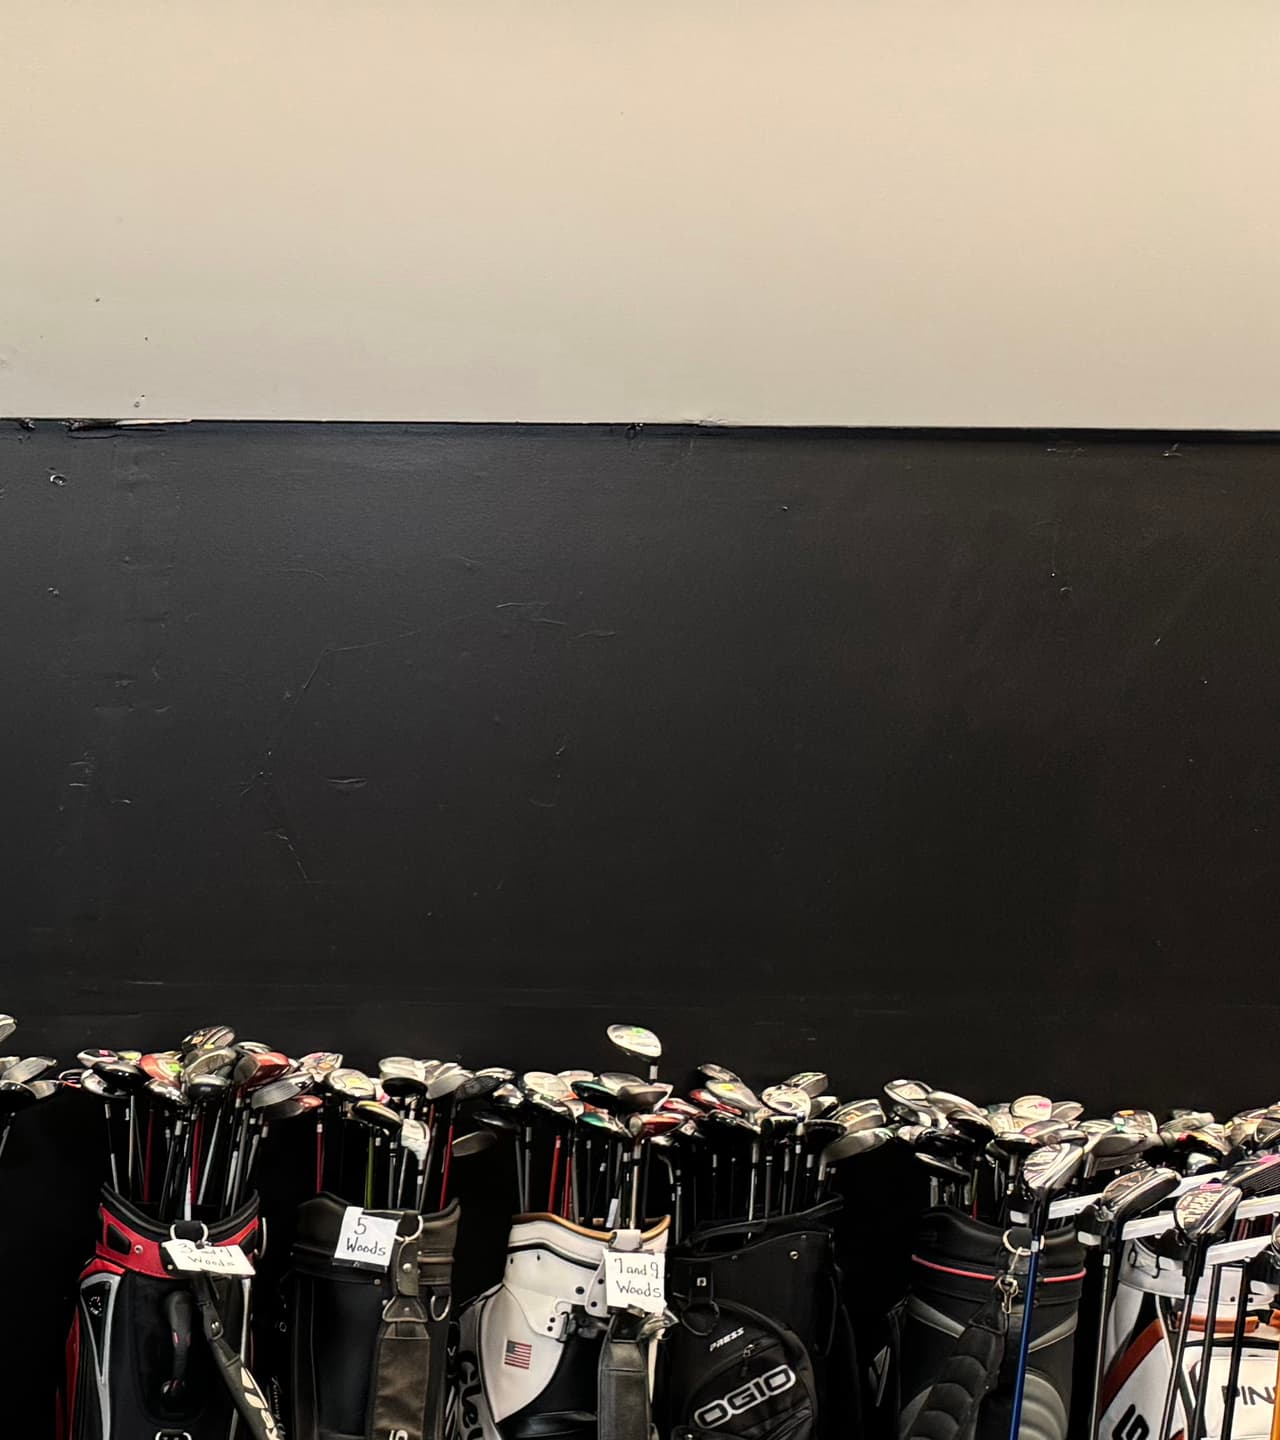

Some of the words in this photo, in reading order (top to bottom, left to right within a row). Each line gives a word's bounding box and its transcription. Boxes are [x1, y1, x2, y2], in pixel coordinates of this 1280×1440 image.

[353, 1216, 368, 1236] 5
[345, 1236, 387, 1257] Woods
[187, 1255, 236, 1267] Woods
[614, 1257, 624, 1275] 7
[626, 1263, 647, 1276] and
[650, 1261, 660, 1280] 9
[615, 1280, 663, 1299] Woods
[708, 1326, 745, 1352] PRESS
[693, 1363, 797, 1430] OGIO
[1221, 1384, 1278, 1406] PIN
